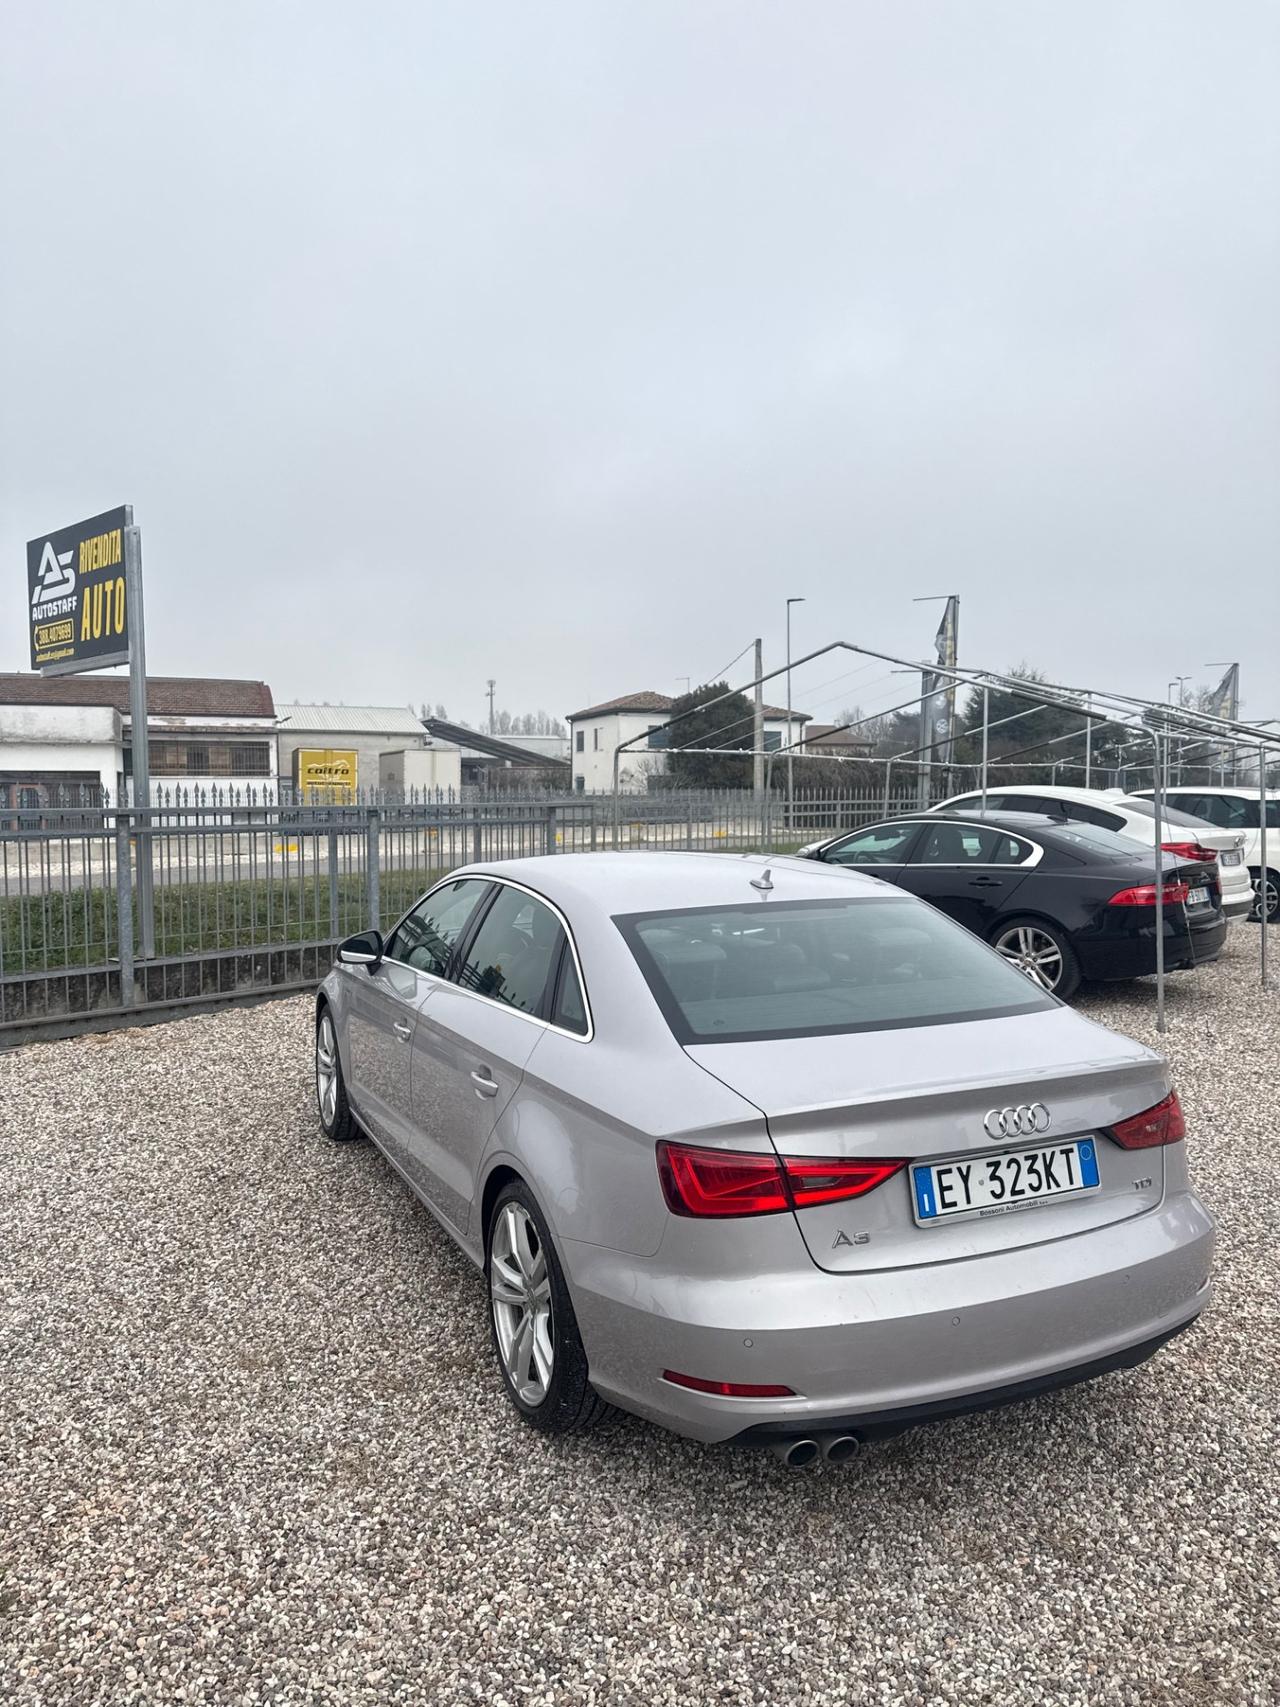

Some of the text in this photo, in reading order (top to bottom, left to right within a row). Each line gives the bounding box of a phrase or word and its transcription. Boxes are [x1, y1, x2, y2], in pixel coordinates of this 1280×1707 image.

[79, 529, 121, 574] RIVENDITA
[32, 597, 77, 621] AUTOSTAFF
[81, 576, 125, 642] AUTO
[936, 1148, 1075, 1209] EY 323KT
[979, 1206, 1005, 1217] Bossoni
[1005, 1201, 1039, 1212] Automobili
[832, 1229, 871, 1249] A3
